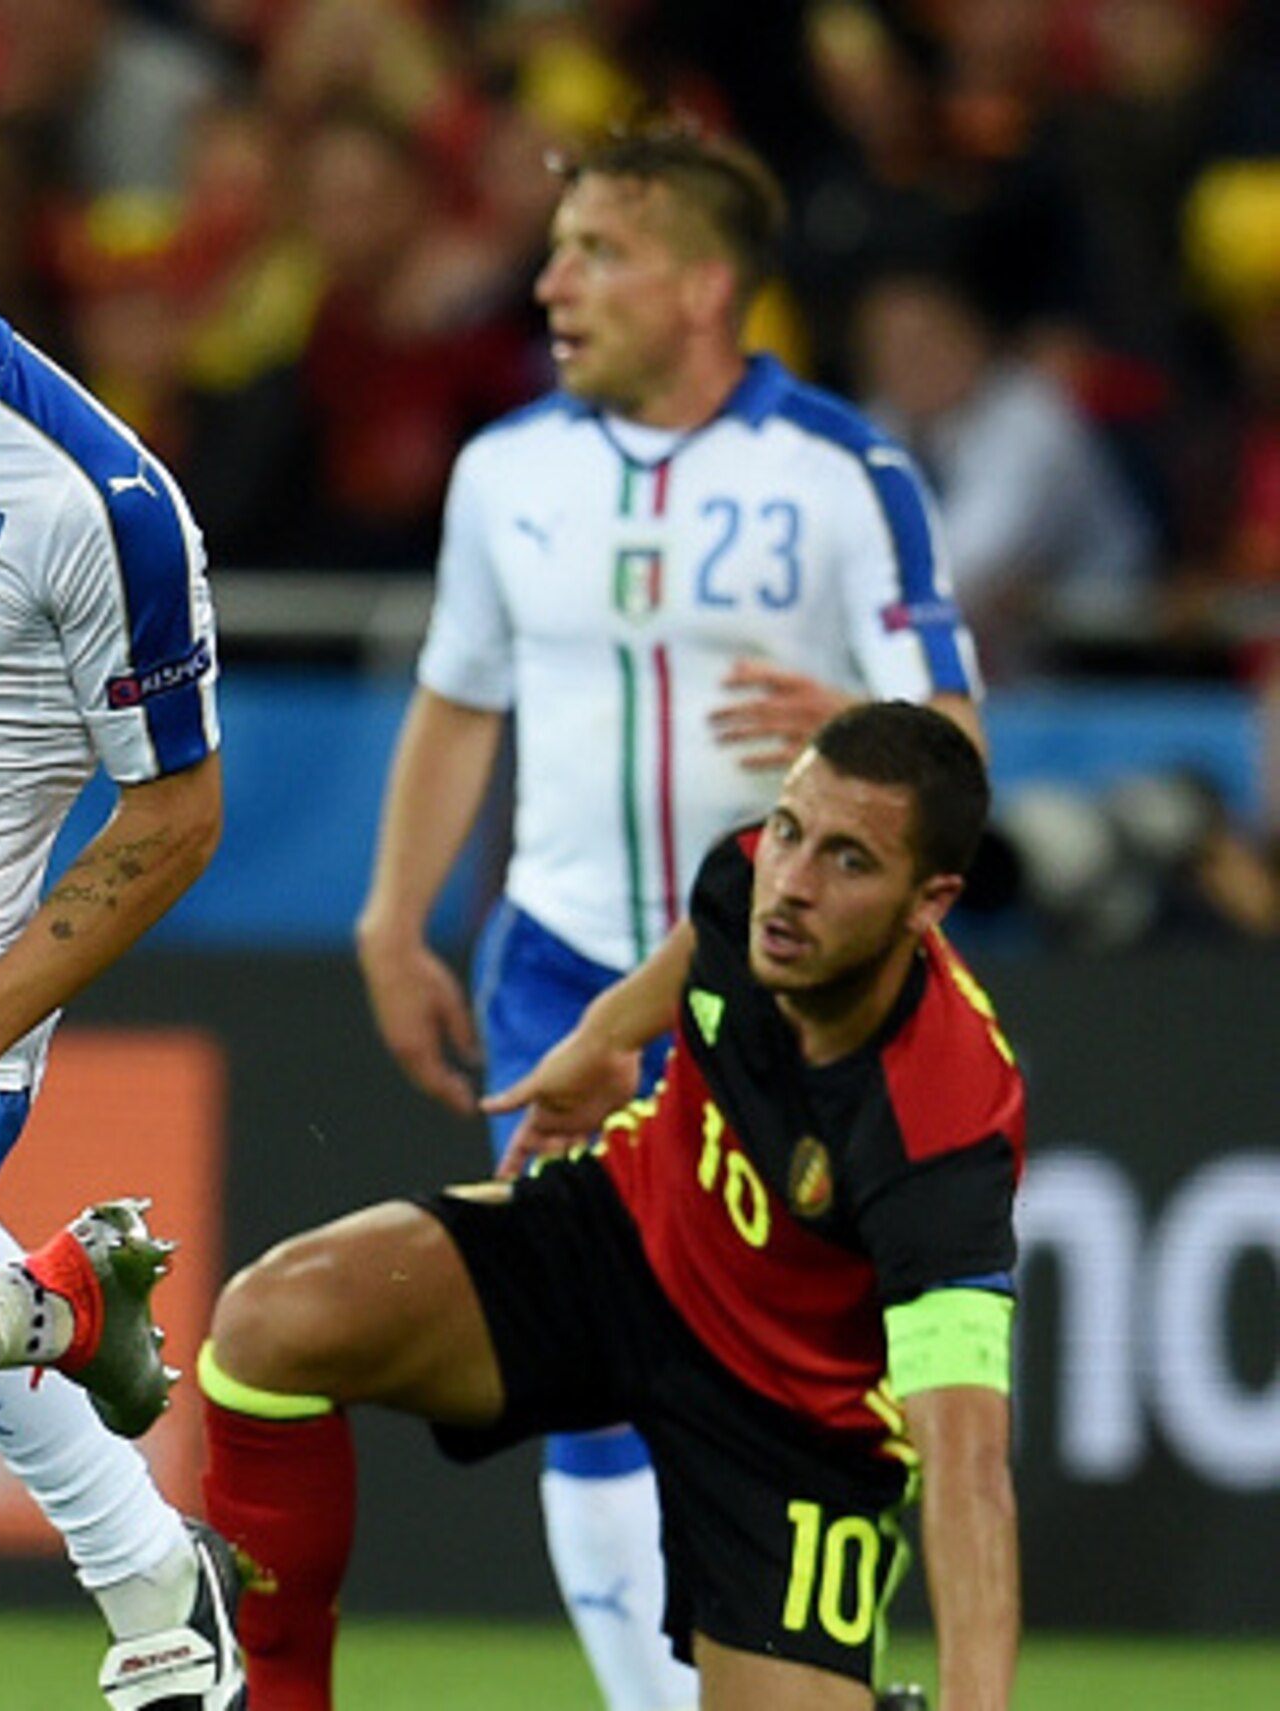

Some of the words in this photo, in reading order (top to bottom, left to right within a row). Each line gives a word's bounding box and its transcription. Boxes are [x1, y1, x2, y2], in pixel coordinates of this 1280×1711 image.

[698, 499, 801, 609] 23
[698, 1100, 770, 1247] 10
[782, 1499, 880, 1645] 10
